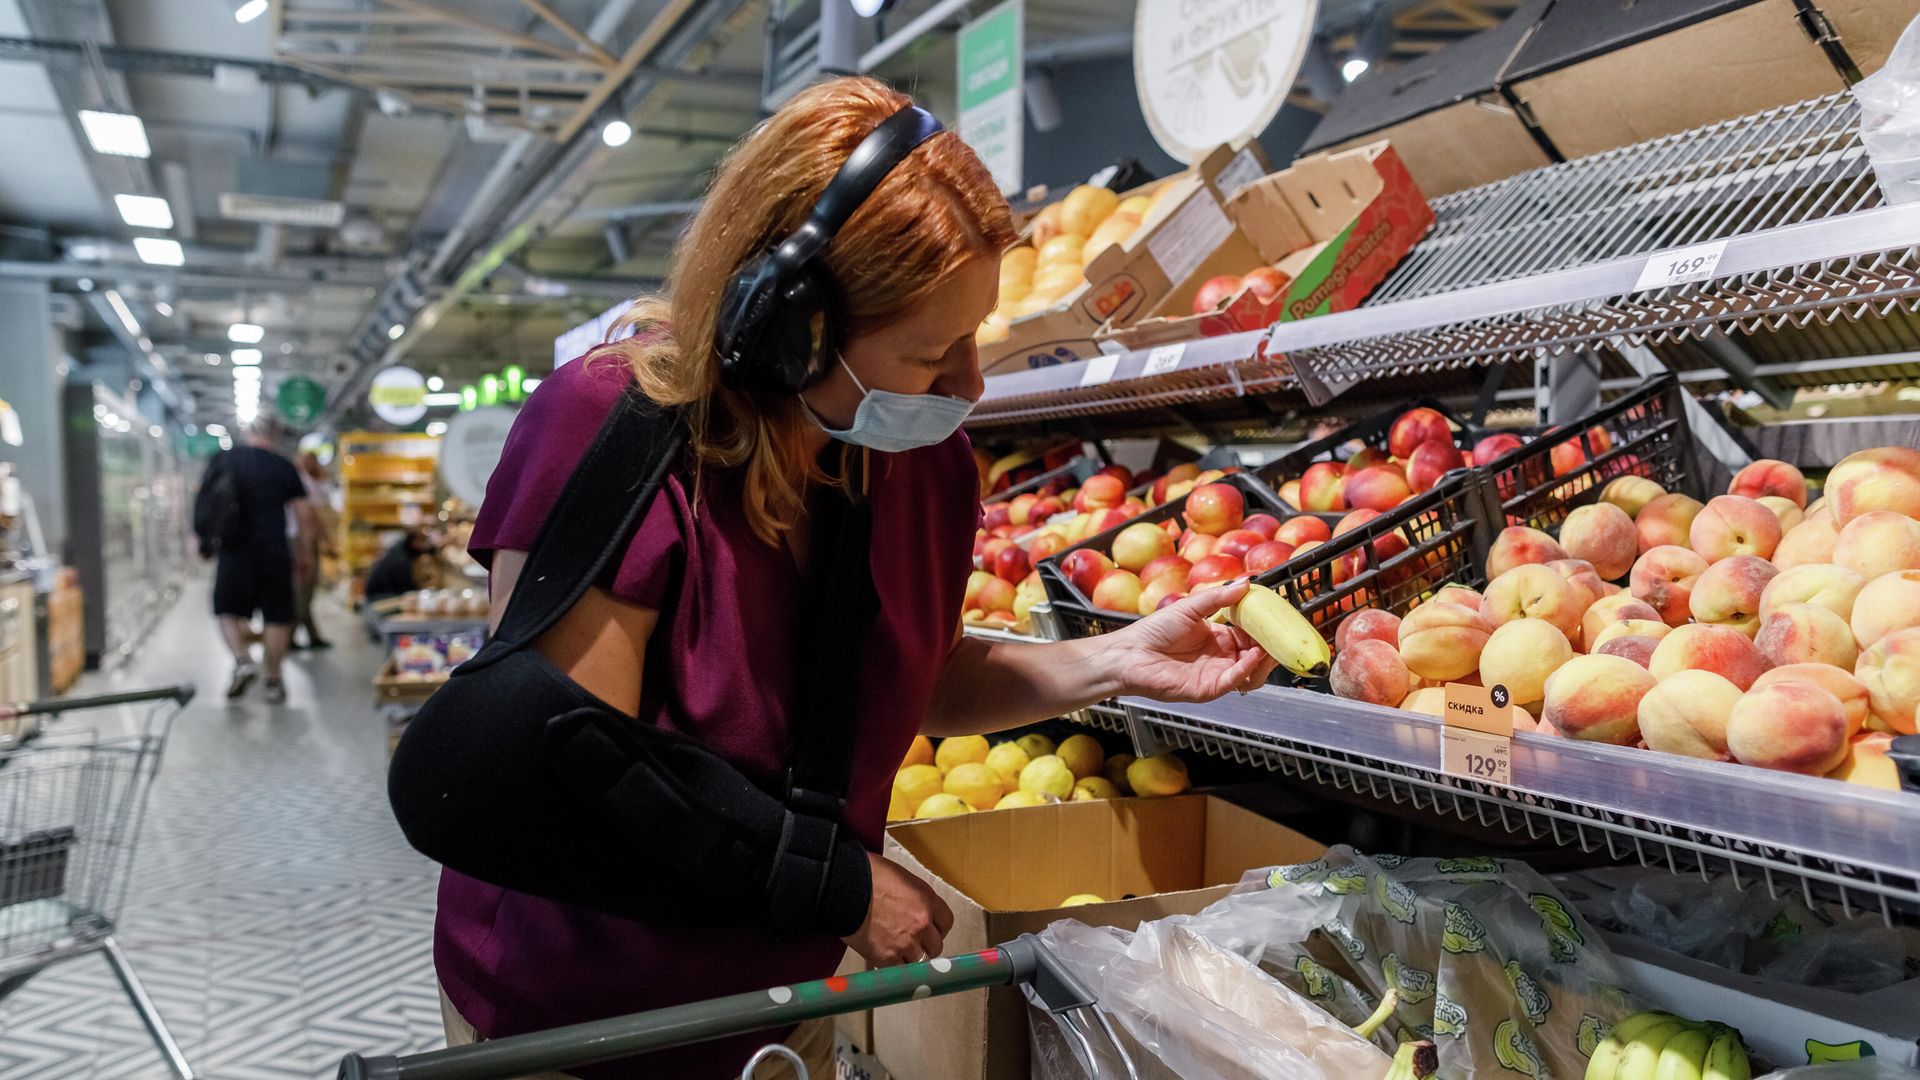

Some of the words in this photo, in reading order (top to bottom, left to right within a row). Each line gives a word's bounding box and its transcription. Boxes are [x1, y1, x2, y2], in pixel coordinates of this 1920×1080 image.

[1290, 218, 1392, 320] Pomegranates
[1668, 257, 1705, 277] 169
[1448, 702, 1484, 715] скидка
[1466, 754, 1496, 777] 129
[1498, 760, 1507, 768] 99
